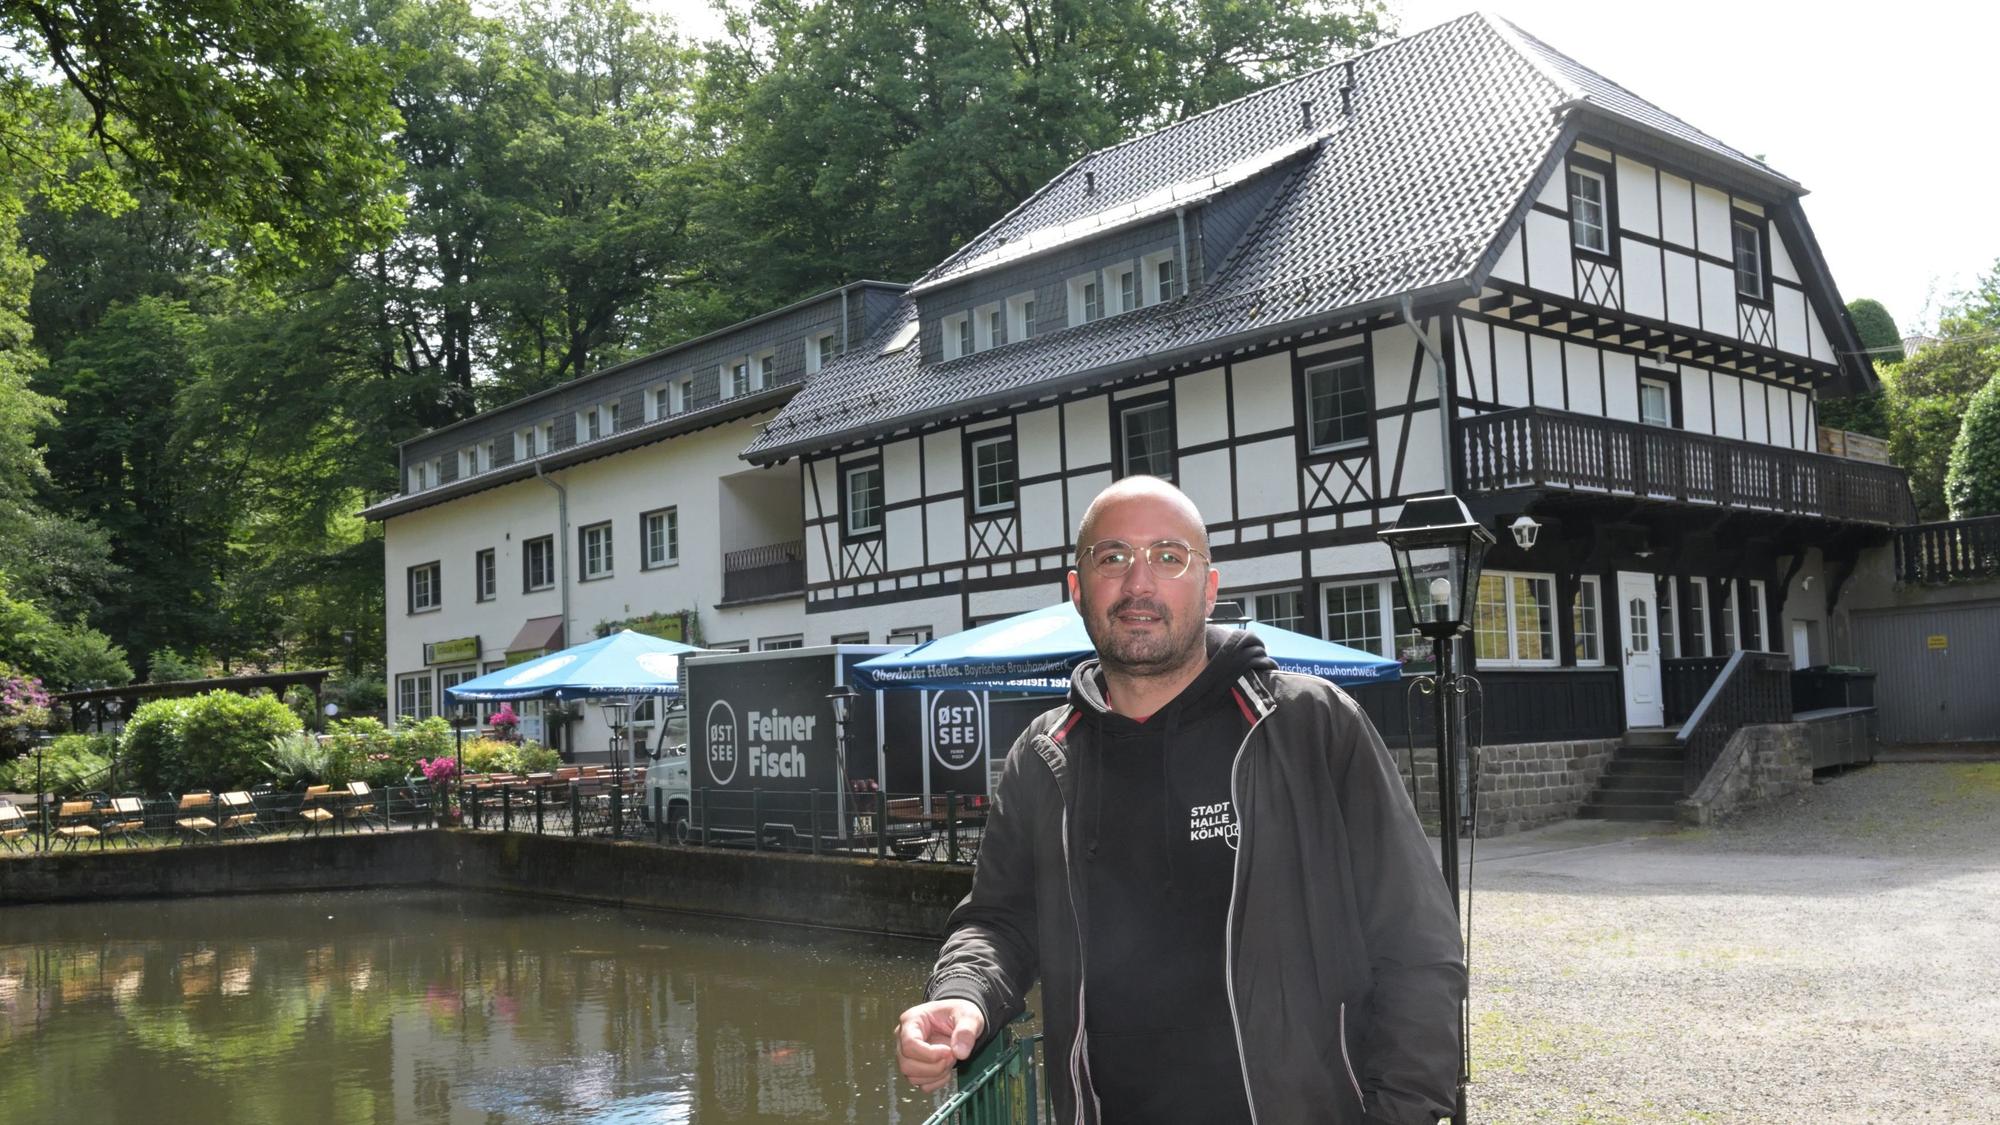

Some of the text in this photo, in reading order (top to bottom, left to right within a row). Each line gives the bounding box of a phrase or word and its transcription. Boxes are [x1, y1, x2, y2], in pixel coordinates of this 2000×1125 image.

[872, 666, 926, 682] Oberdorfer
[927, 664, 962, 678] Helles.
[747, 708, 816, 742] Feiner
[938, 705, 975, 727] ØST
[710, 724, 733, 743] ØST
[939, 727, 975, 745] SEE
[711, 745, 733, 761] SEE
[748, 744, 806, 778] Fisch
[1191, 801, 1230, 817] STADT
[1190, 813, 1230, 829] HALLE
[1190, 827, 1224, 841] KÖLN
